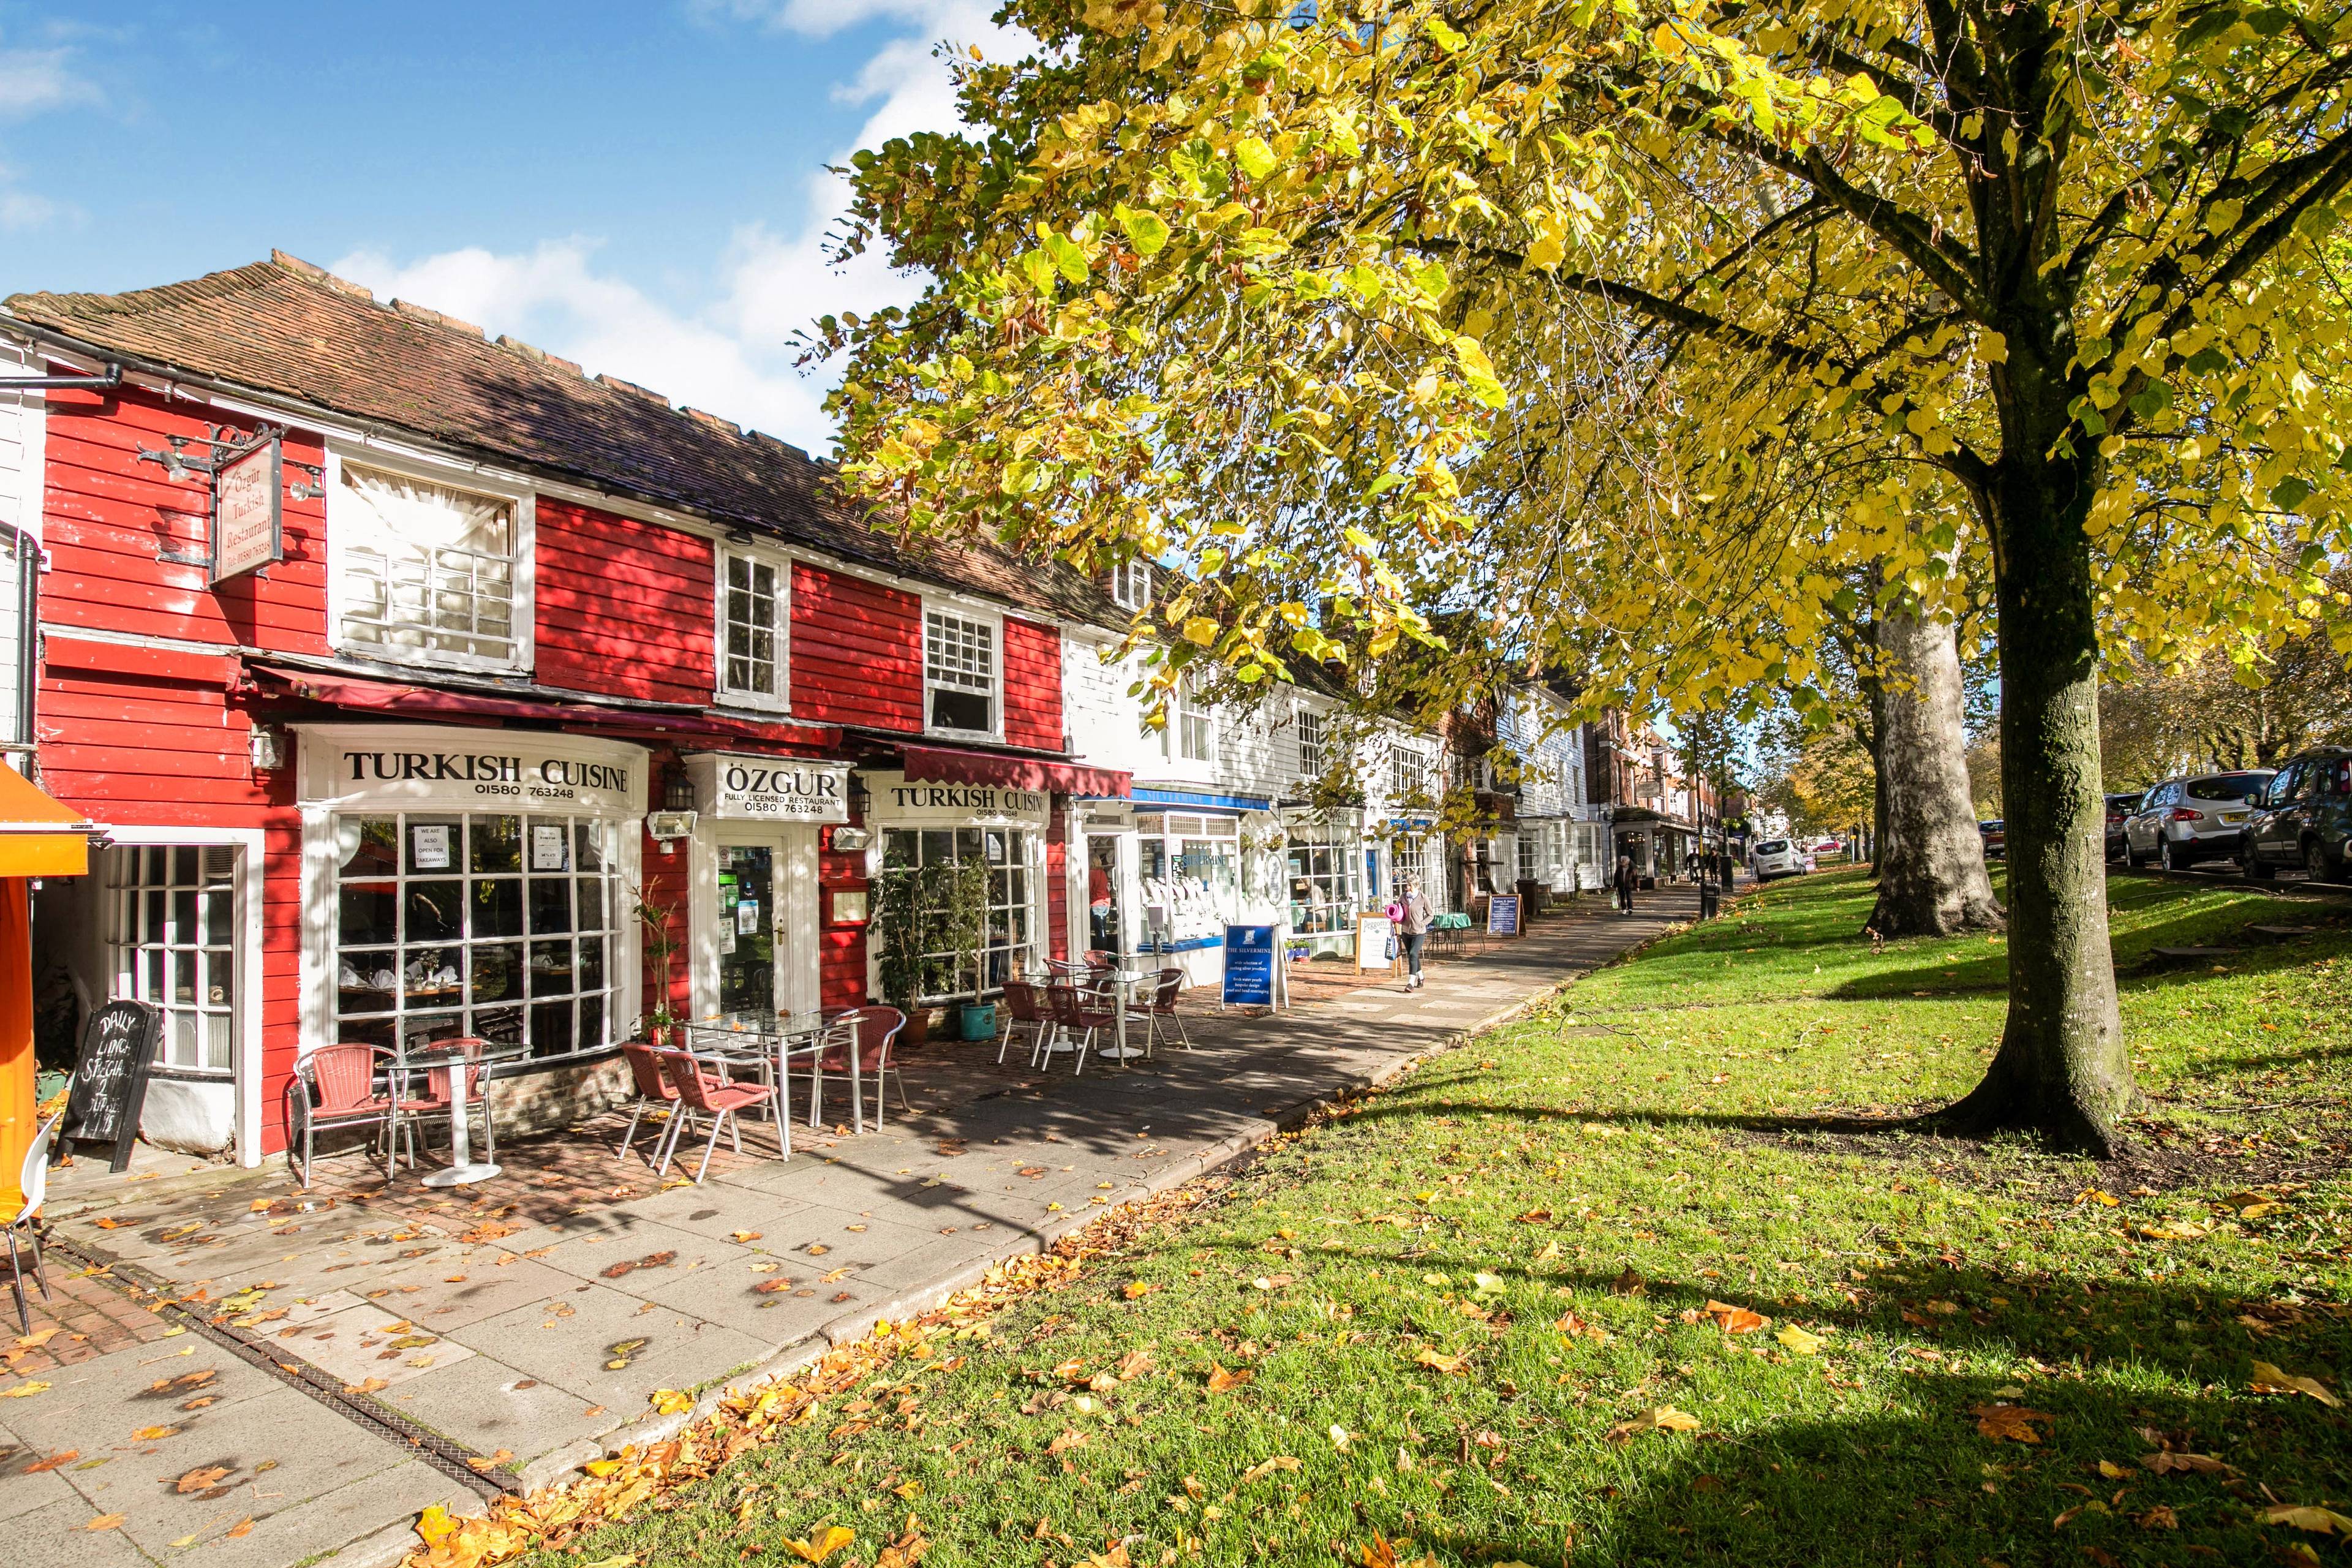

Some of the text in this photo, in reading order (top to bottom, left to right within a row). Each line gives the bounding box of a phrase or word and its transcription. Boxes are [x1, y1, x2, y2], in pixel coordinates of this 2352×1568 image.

[235, 468, 260, 492] Özgür
[233, 491, 264, 520] Turkish
[227, 514, 271, 548] Restaurant
[237, 549, 252, 564] 01580
[252, 540, 270, 557] 763248
[344, 752, 627, 793] TURKISH CUISINE
[726, 763, 837, 797] ÖZGÜR
[475, 784, 573, 798] 01580 763248
[749, 794, 785, 803] LICENSED
[789, 797, 840, 806] RESTAURANT
[891, 788, 995, 808] TURKISH
[745, 802, 823, 813] 01580 763248
[100, 1010, 136, 1035] DAILY
[81, 1058, 133, 1082] SPECIA
[96, 1079, 108, 1096] 2
